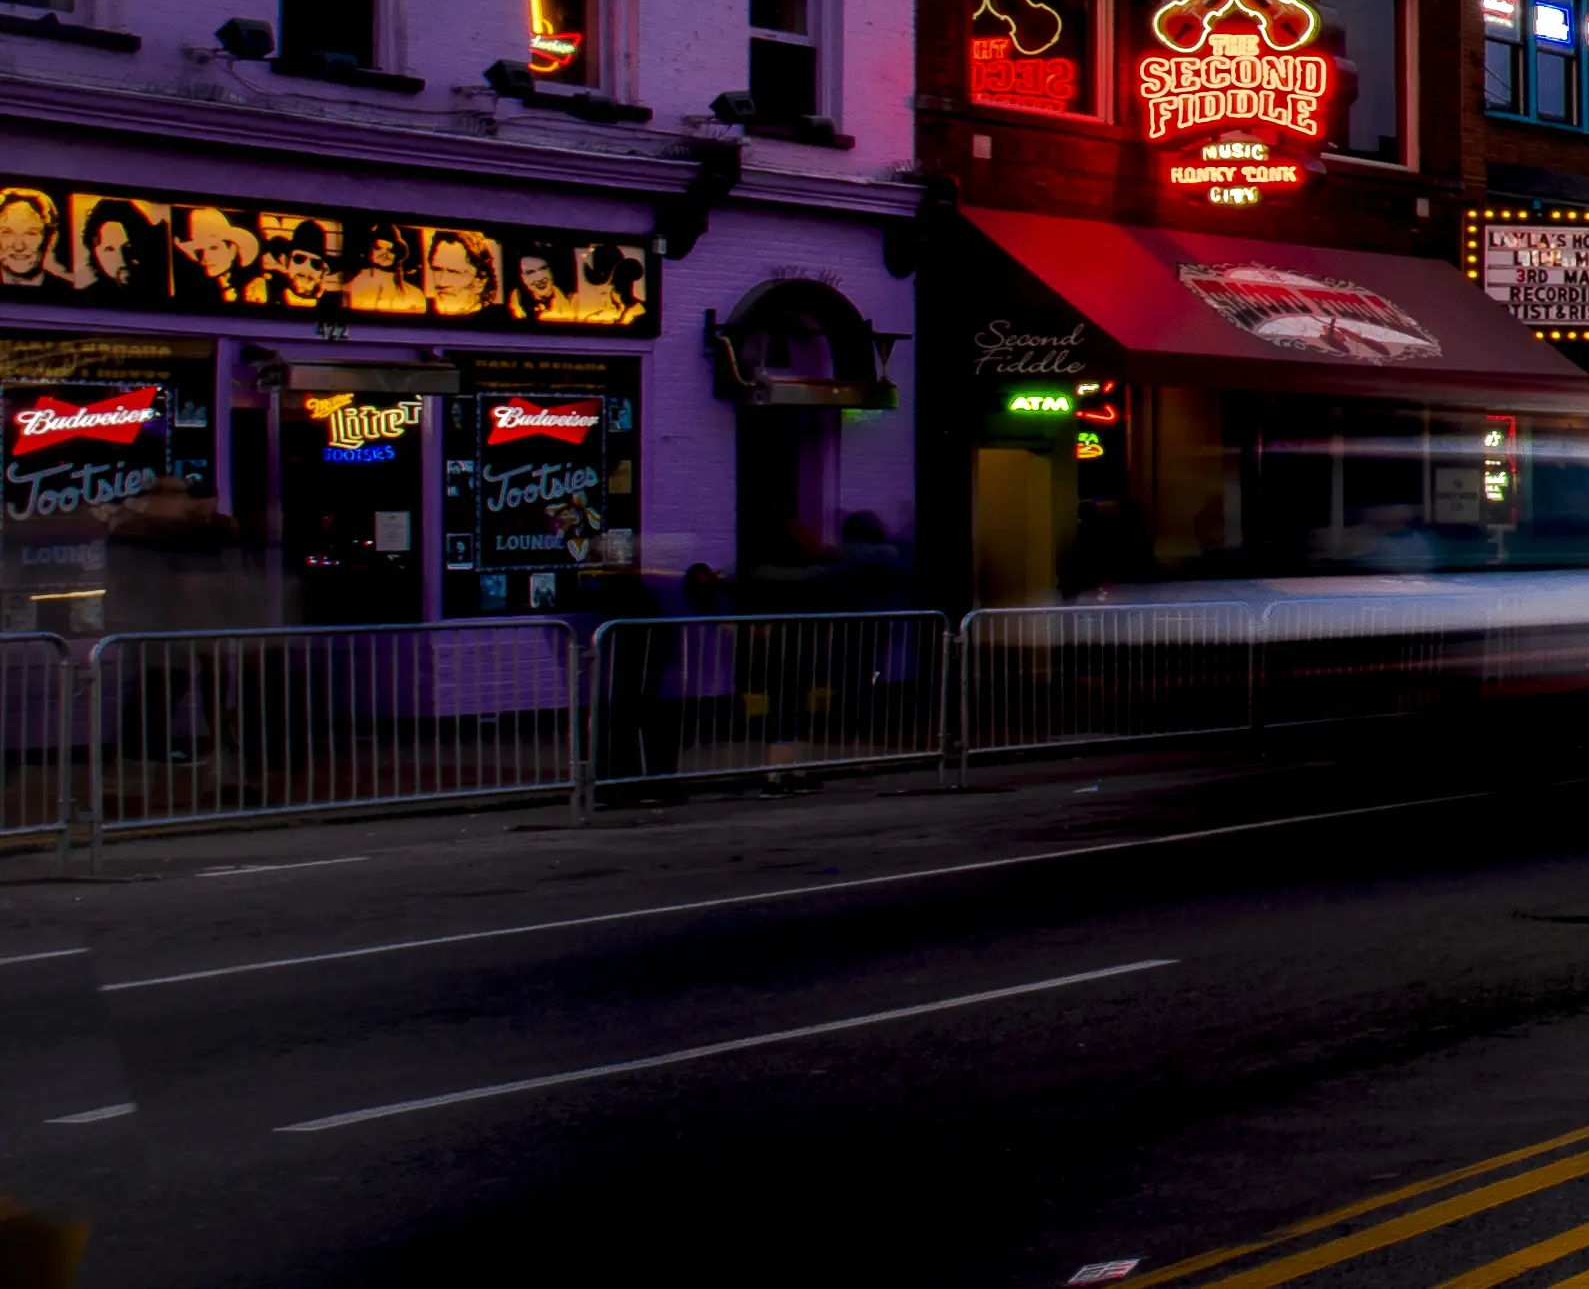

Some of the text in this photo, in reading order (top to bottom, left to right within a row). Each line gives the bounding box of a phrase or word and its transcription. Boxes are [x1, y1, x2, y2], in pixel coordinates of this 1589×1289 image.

[1208, 34, 1260, 57] THE
[1140, 56, 1327, 98] SECOND
[1149, 90, 1318, 139] FIDDLE
[1202, 142, 1265, 161] MUSIC
[1170, 166, 1297, 184] HONKY TONK
[1209, 186, 1258, 204] CITY
[1489, 231, 1567, 249] LAYLA'S
[1516, 268, 1549, 284] 3RD
[974, 319, 1086, 349] Second
[972, 346, 1087, 376] Fiddle
[1010, 396, 1070, 412] ATM
[17, 405, 154, 436] Budweiser
[328, 405, 405, 450] Lite
[493, 406, 600, 428] Budweiser
[324, 445, 396, 462] TOOTSIES
[483, 462, 599, 512] Tootsies
